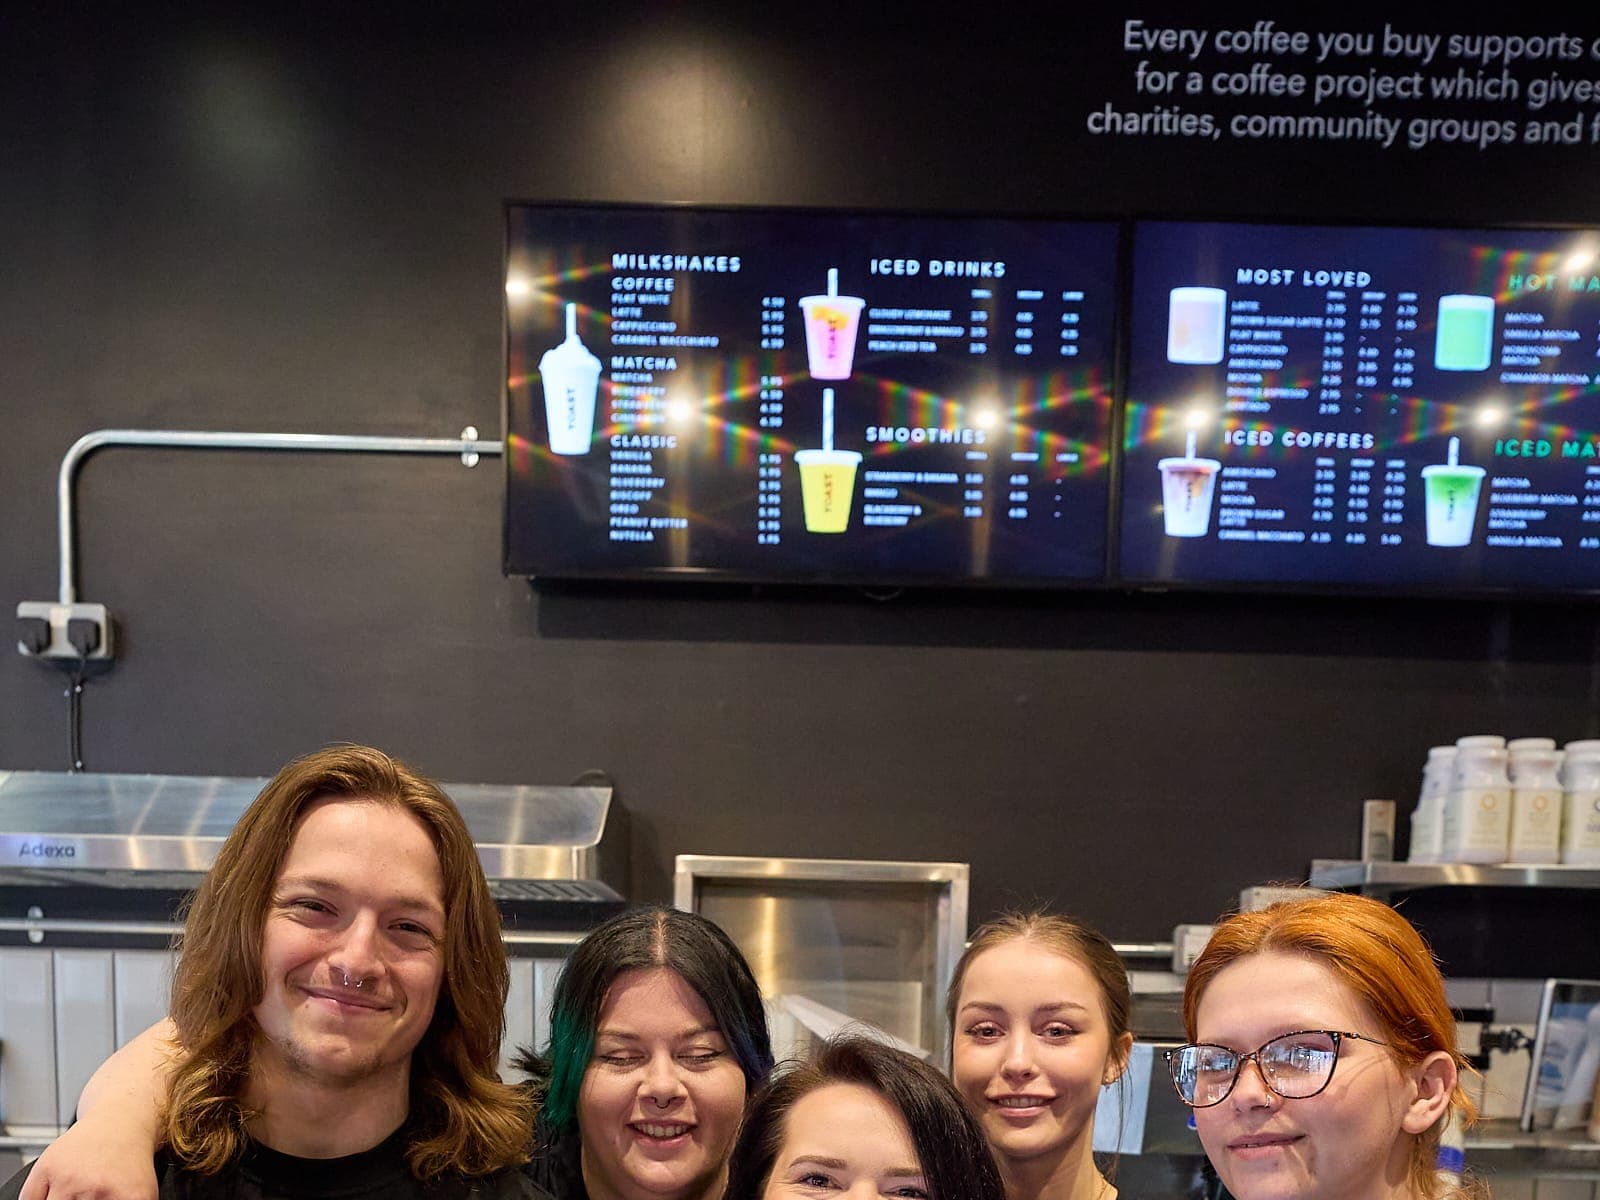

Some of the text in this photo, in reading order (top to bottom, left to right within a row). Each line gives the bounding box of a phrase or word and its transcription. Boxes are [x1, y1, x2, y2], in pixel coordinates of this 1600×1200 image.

[1123, 20, 1207, 60] Every
[1214, 21, 1309, 56] coffee
[1317, 30, 1374, 62] you
[1383, 24, 1441, 64] buy
[1447, 31, 1583, 67] supports
[1135, 60, 1179, 95] for
[1186, 71, 1203, 94] a
[1211, 62, 1306, 97] coffee
[1314, 69, 1424, 106] project
[1430, 68, 1520, 101] which
[1087, 102, 1222, 140] charities,
[1230, 110, 1401, 149] community
[1408, 118, 1516, 151] groups
[1524, 111, 1584, 144] and
[612, 253, 741, 272] MILKSHAKES
[870, 258, 1006, 278] ICED DRINKS
[611, 277, 675, 291] COFFEE
[1236, 268, 1371, 288] MOST LOVED
[1508, 274, 1556, 291] HOT
[611, 356, 677, 371] MATCHA
[610, 434, 677, 448] CLASSIC
[865, 426, 987, 444] SMOOTHIES
[1224, 429, 1374, 449] ICED COFFEES
[1494, 438, 1600, 458] ICED MA
[19, 842, 76, 858] Adexa
